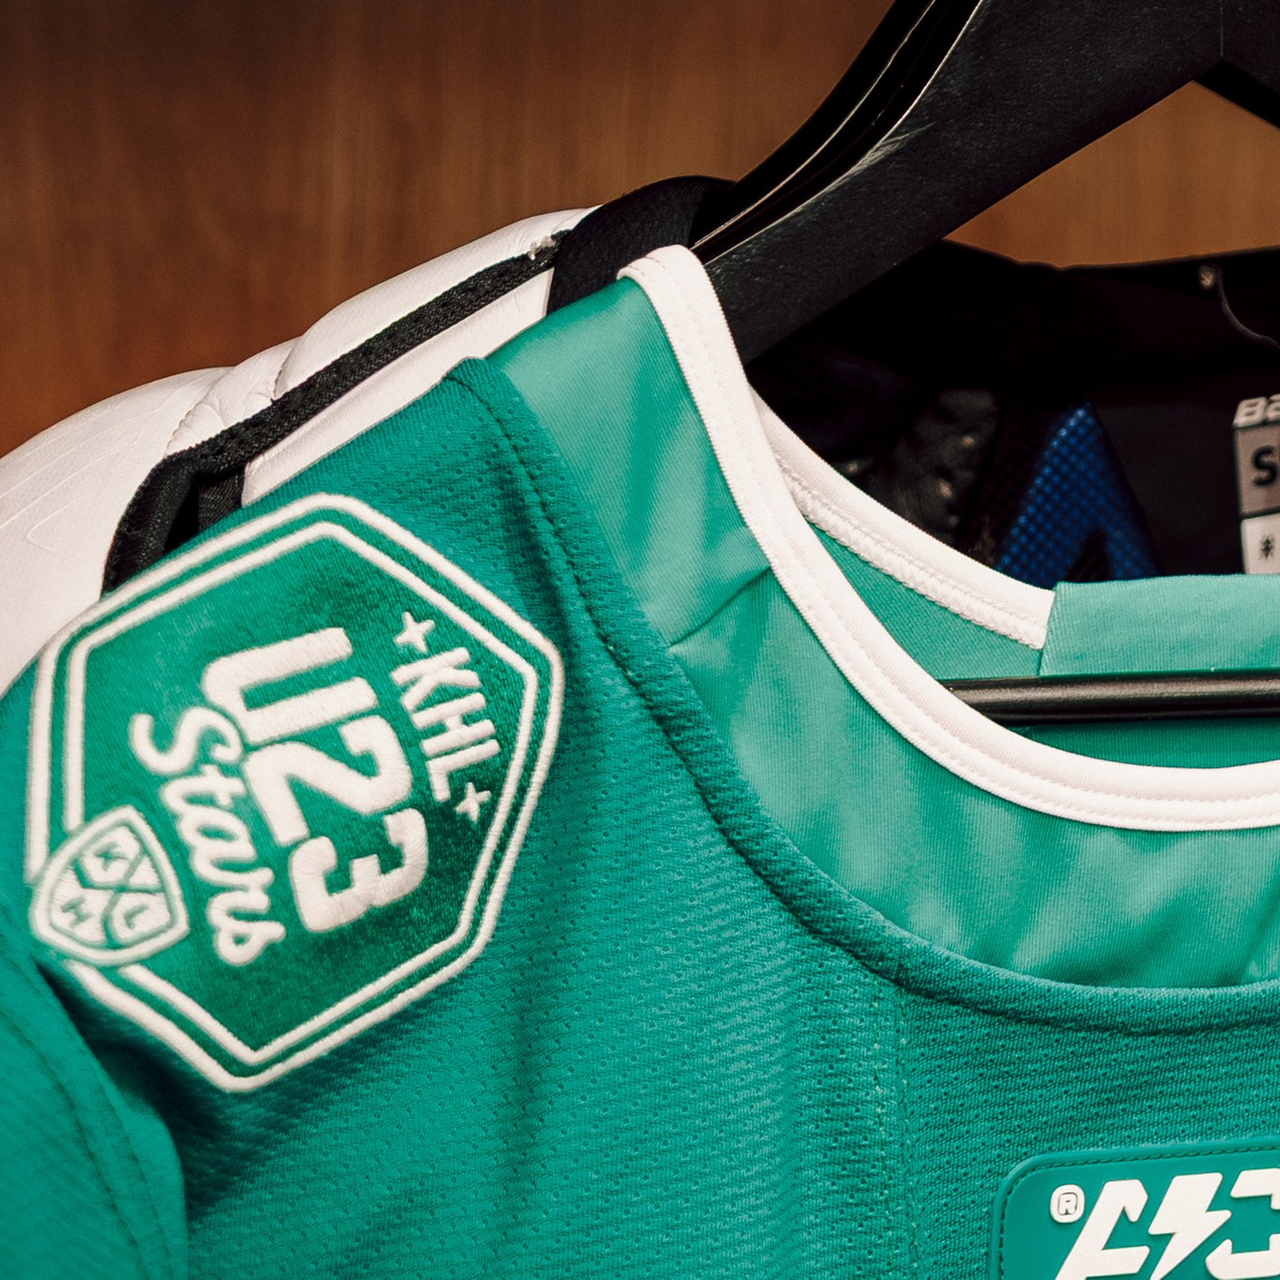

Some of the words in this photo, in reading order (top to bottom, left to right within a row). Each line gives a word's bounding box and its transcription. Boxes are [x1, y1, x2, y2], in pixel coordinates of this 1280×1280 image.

[129, 706, 287, 966] Stars
[201, 627, 428, 932] U23
[390, 646, 500, 802] KHL
